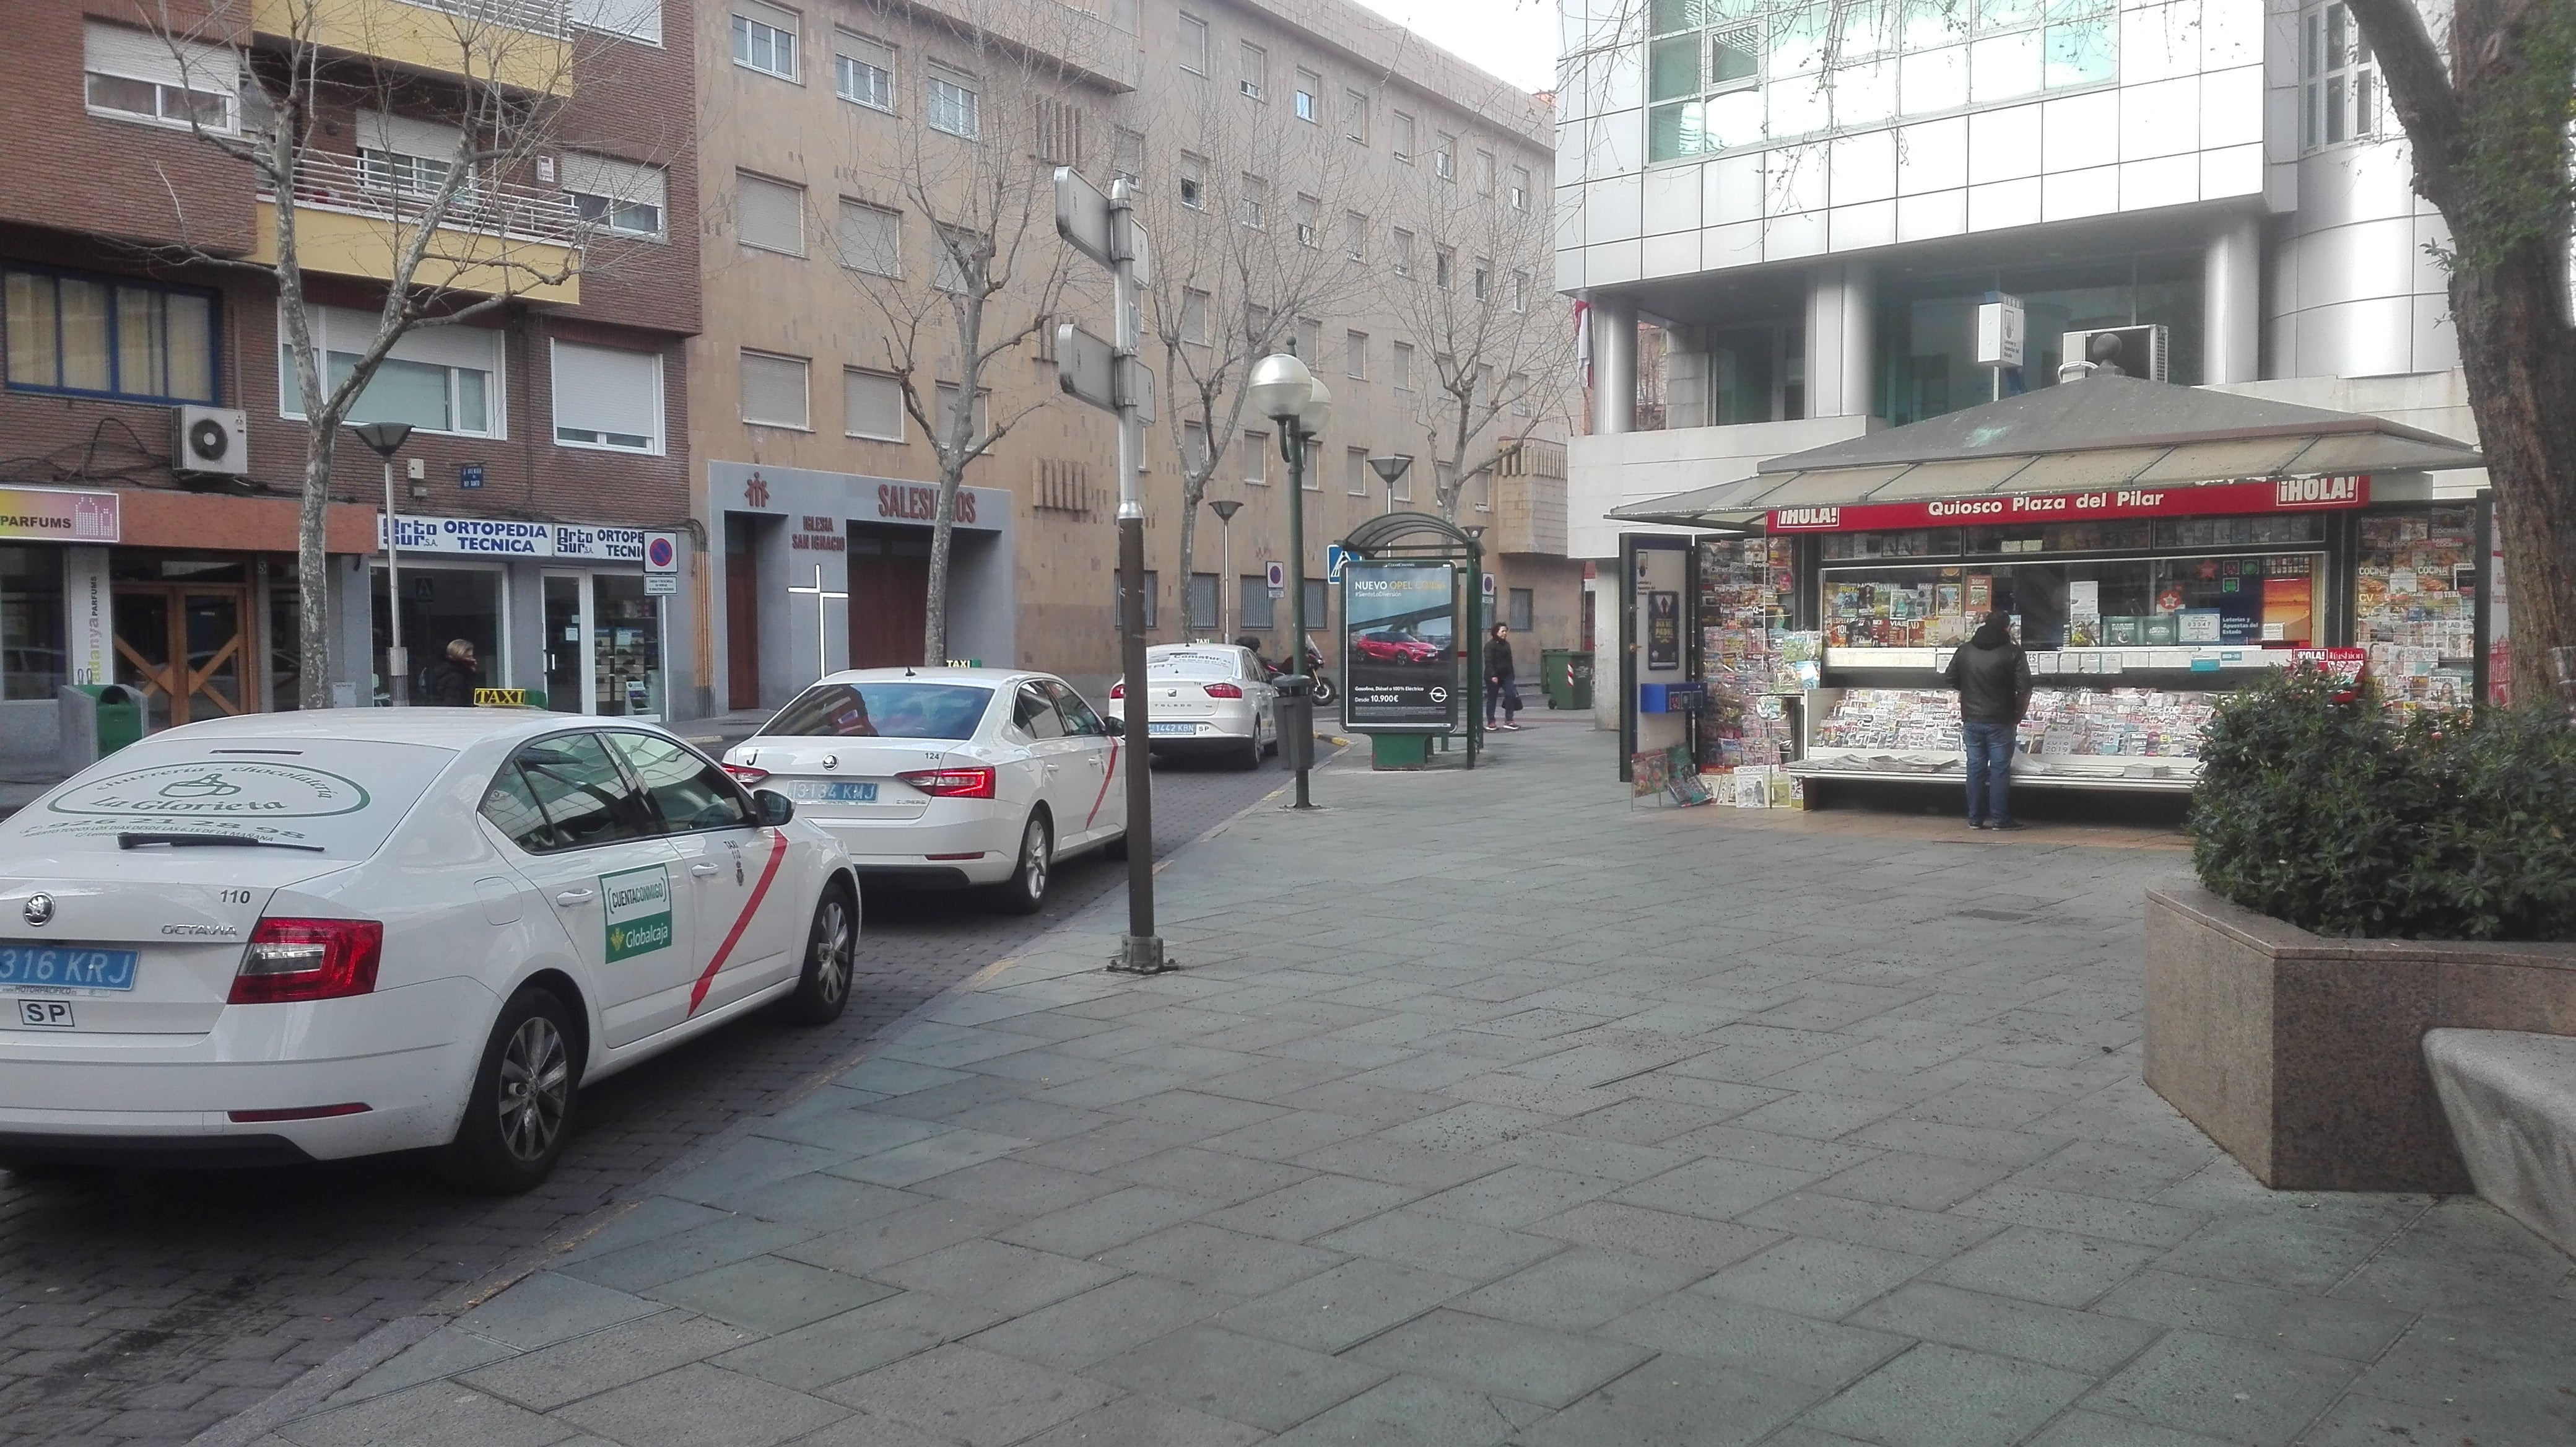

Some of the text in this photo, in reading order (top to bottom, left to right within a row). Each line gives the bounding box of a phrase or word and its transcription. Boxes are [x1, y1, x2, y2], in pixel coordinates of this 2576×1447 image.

[2280, 476, 2356, 502] ¡HOLA!
[879, 484, 976, 523] SALESIOS
[1928, 491, 2164, 516] Quiosco Plaza del Pilar
[0, 515, 71, 530] PARFUMS
[444, 520, 548, 538] ORTOPEDIA
[803, 515, 833, 531] IGLESIA
[598, 529, 643, 543] ORTOPE
[792, 533, 845, 551] SAN IGNACIO
[457, 536, 536, 553] TECNICA
[606, 544, 643, 557] TECNI
[2359, 567, 2388, 575] COCINA
[2418, 566, 2448, 575] COCINA
[1355, 581, 1388, 590] NUEVO
[1390, 581, 1412, 590] OPEL
[2359, 593, 2374, 601] CV
[946, 660, 970, 668] TAXI
[475, 689, 524, 705] TAXI
[1157, 724, 1194, 732] 1442 KBN
[925, 752, 940, 760] 124
[798, 784, 875, 800] 3134 KMJ
[90, 796, 289, 811] La Glorieta
[47, 818, 118, 829] 926
[189, 820, 242, 829] 28
[255, 826, 306, 839] 98
[723, 839, 739, 850] TAXI
[731, 849, 741, 860] 110
[220, 889, 251, 904] 110
[161, 924, 238, 936] OCTAVIA
[625, 922, 668, 948] Globalcaja
[0, 949, 131, 984] 316 KRJ
[27, 1003, 66, 1023] SP
